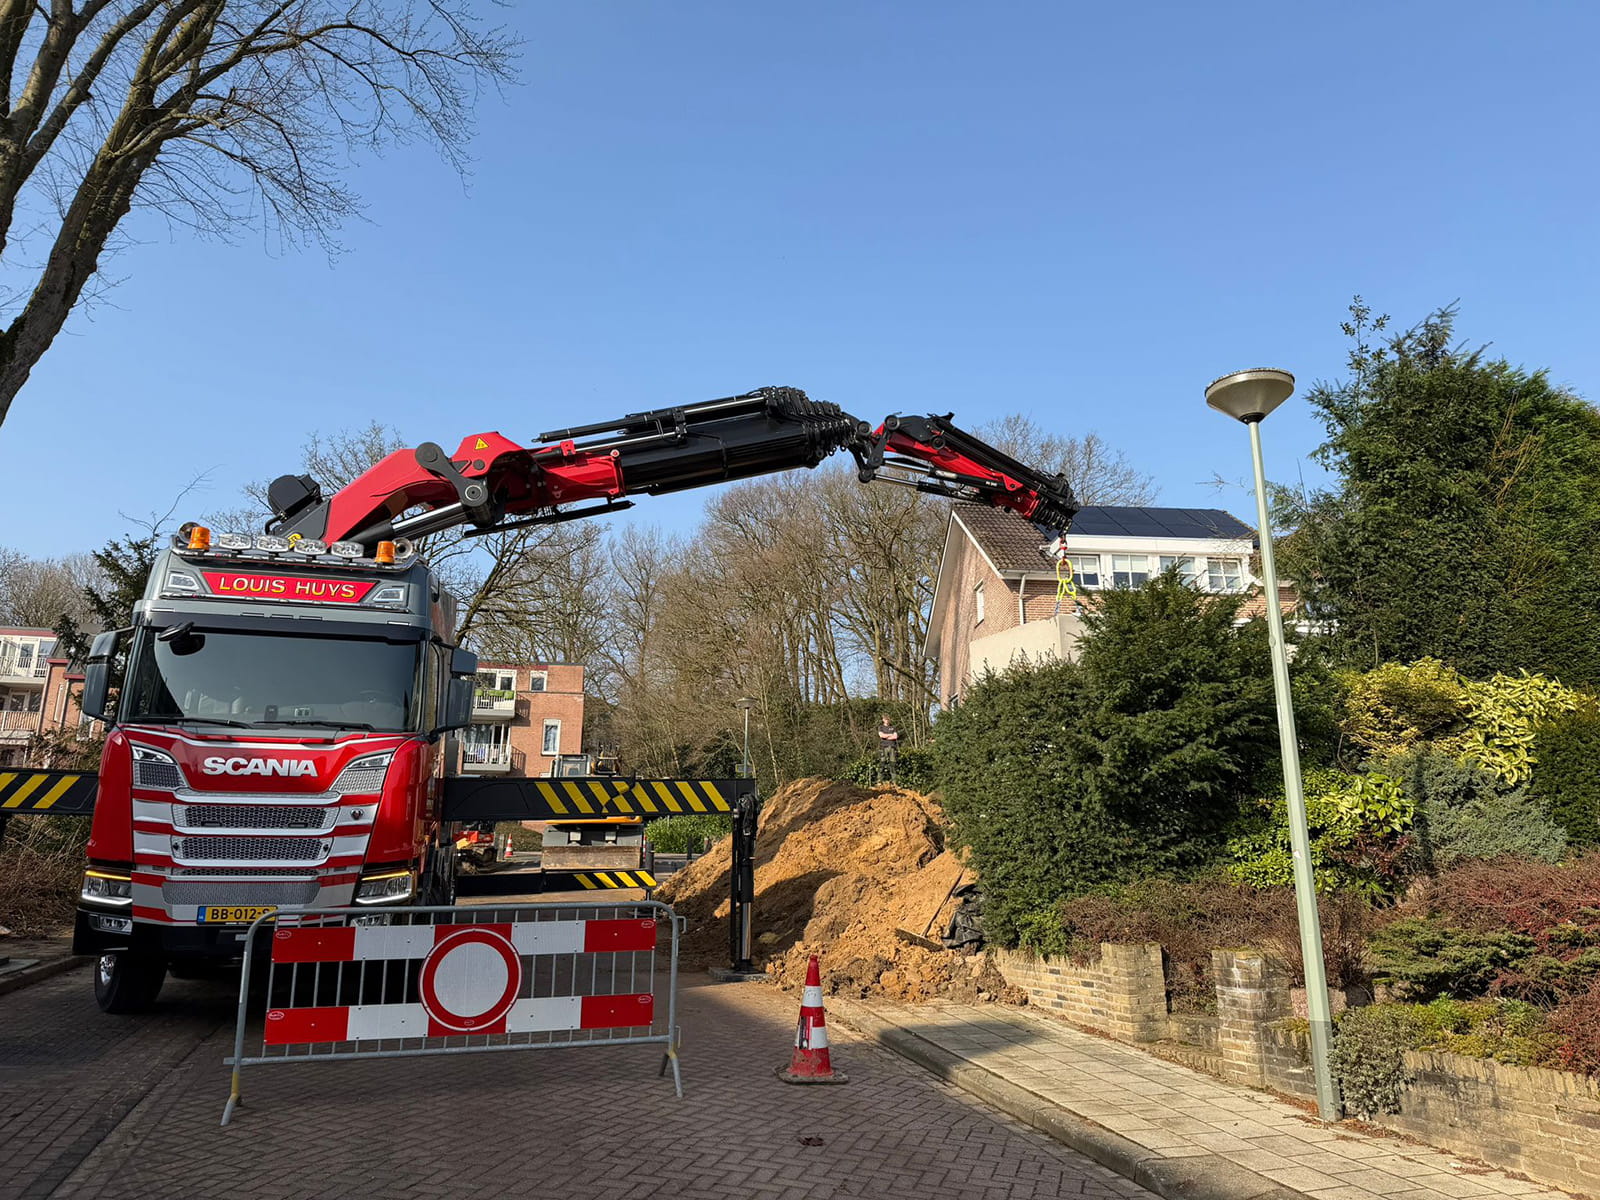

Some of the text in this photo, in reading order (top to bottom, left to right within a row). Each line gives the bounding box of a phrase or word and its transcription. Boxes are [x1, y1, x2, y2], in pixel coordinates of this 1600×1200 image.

[219, 576, 356, 598] LOUIS HUYS
[202, 756, 318, 777] SCANIA
